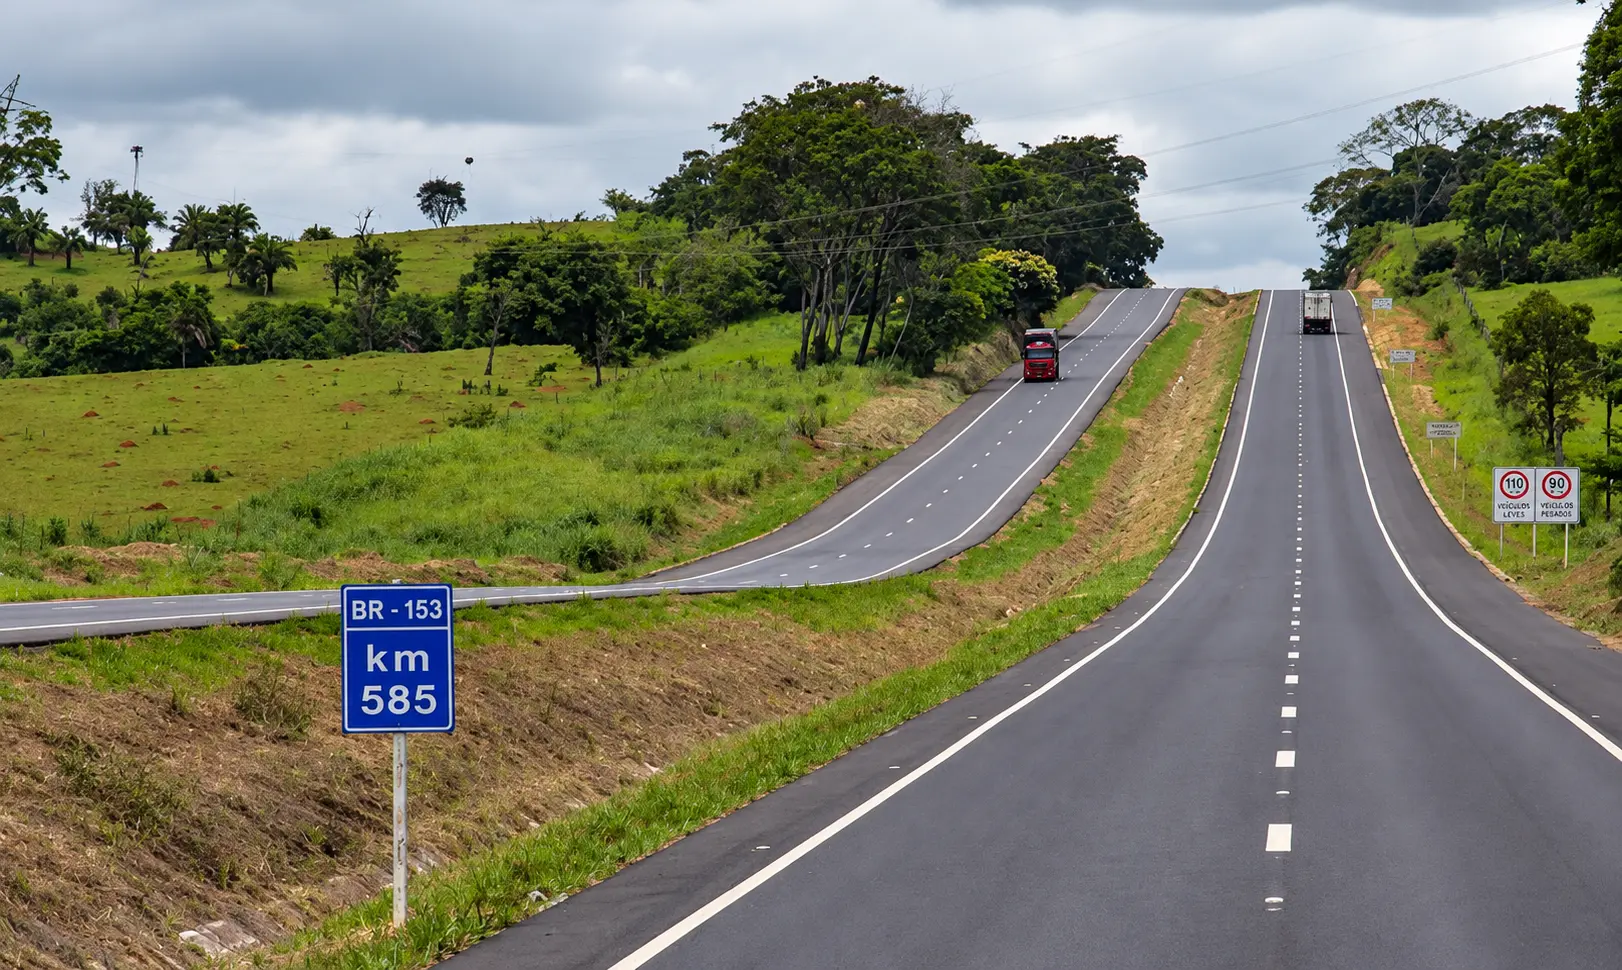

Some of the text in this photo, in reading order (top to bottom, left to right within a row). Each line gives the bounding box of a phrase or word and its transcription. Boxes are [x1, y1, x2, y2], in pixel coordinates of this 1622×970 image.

[1505, 478, 1524, 489] 110
[1549, 478, 1565, 489] 90
[352, 600, 384, 620] BR
[404, 599, 442, 620] 153
[366, 644, 429, 672] km
[361, 684, 437, 715] 585
